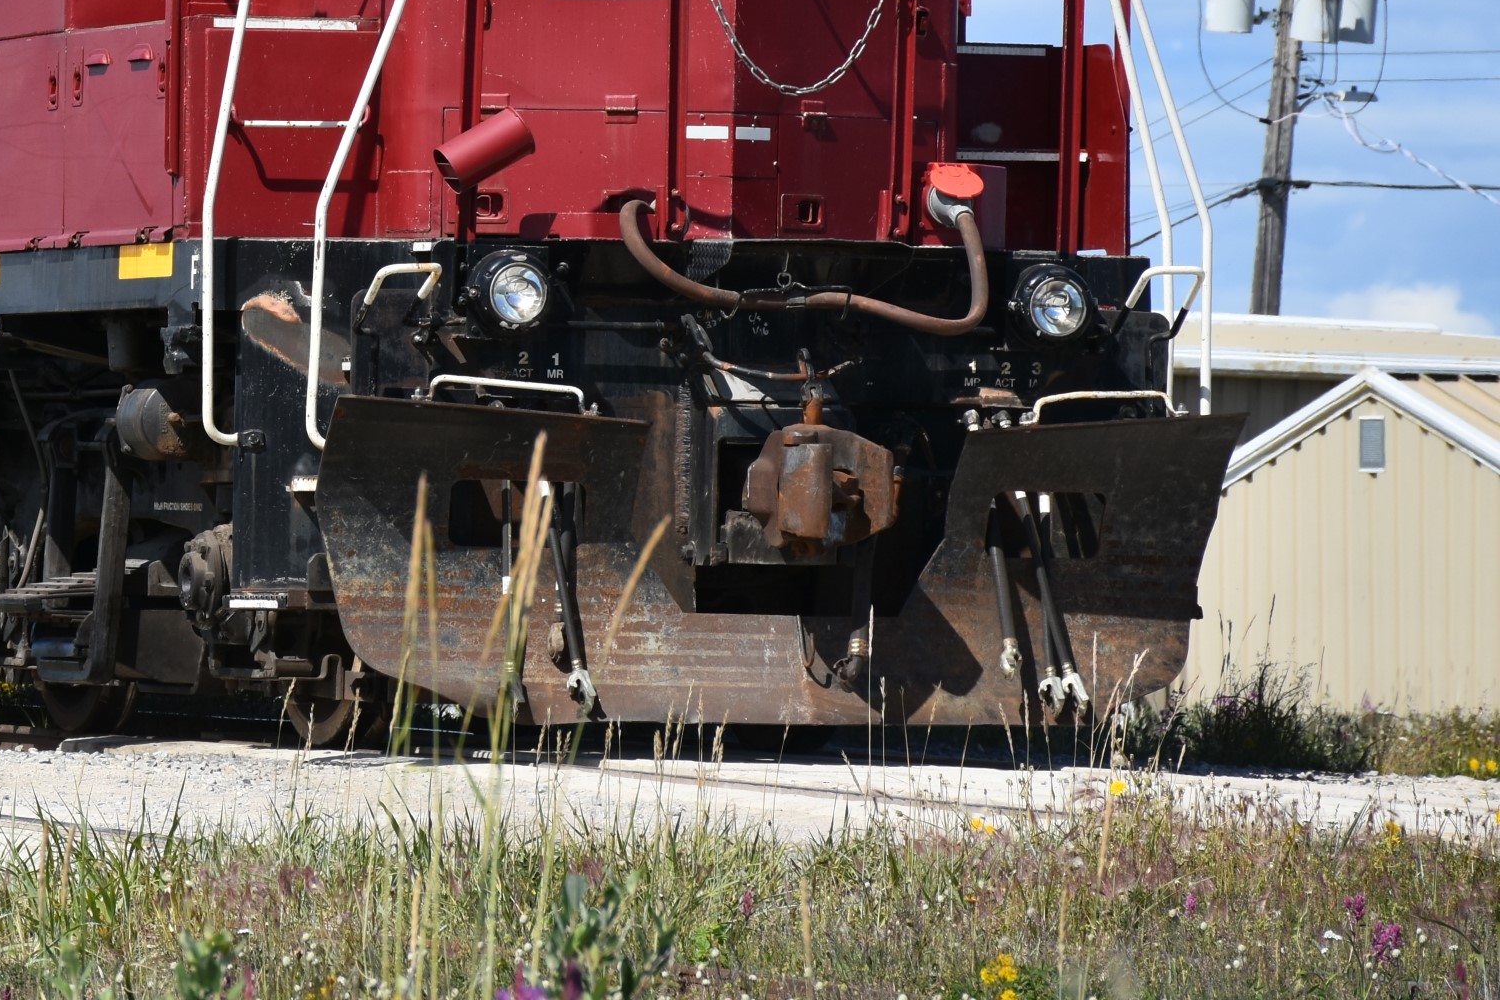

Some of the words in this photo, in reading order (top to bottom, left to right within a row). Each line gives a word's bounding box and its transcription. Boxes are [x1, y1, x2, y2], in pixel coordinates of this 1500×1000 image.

[518, 351, 529, 365] 2
[551, 352, 560, 366] 1
[512, 368, 534, 378] ACT
[546, 369, 564, 379] MR
[968, 360, 977, 374] 1
[1000, 361, 1011, 375] 2
[1031, 361, 1042, 375] 3
[994, 378, 1016, 388] ACT
